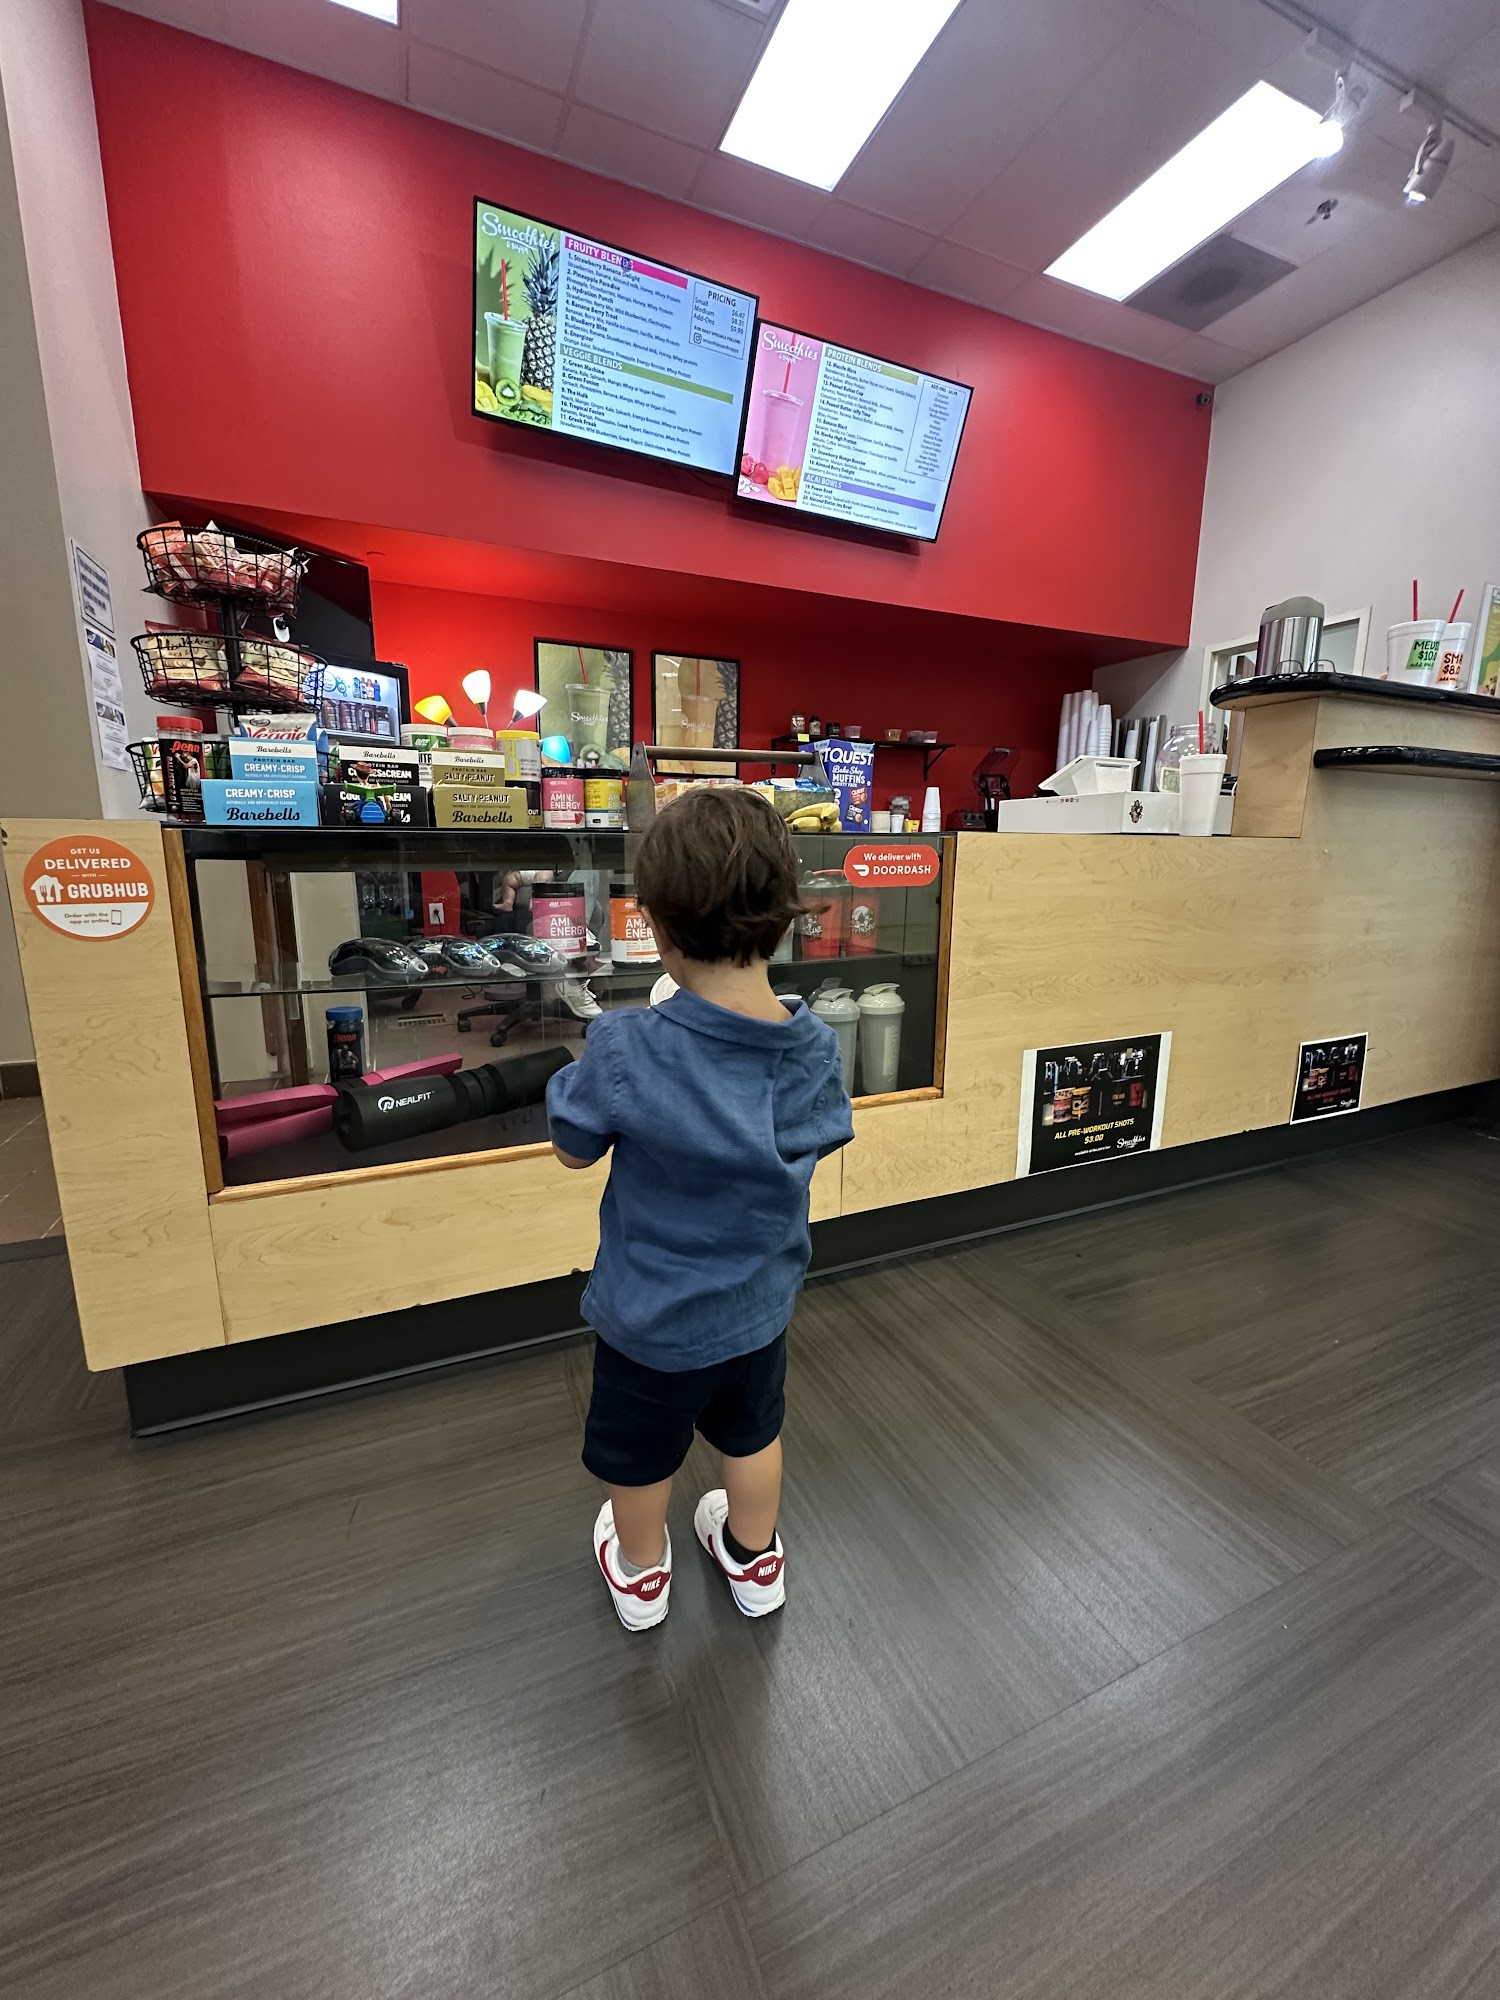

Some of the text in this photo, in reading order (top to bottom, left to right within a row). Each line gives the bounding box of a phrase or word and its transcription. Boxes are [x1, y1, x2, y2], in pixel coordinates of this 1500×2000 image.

[482, 212, 556, 251] Smoothies
[568, 239, 633, 268] FRUITY BLENDS
[574, 254, 601, 270] Strawberry
[602, 264, 621, 275] Banana
[622, 270, 640, 282] Delight
[573, 270, 598, 283] Pineapple
[599, 279, 620, 290] Paradise
[572, 285, 597, 298] Hydration
[598, 294, 613, 303] Punch
[695, 296, 708, 306] Small
[708, 290, 736, 306] PRICING
[571, 300, 590, 311] Banana
[591, 306, 604, 316] Berry
[605, 311, 617, 320] Treat
[694, 305, 714, 316] Medium
[693, 313, 714, 325] Add-Ons
[596, 323, 607, 331] Bliss
[570, 330, 593, 341] Energizer
[762, 331, 818, 360] Smoothies
[563, 346, 622, 369] VEGGIE BLENDS
[827, 349, 881, 372] PROTEIN BLENDS
[568, 359, 583, 368] Green
[584, 364, 604, 374] Machine
[567, 373, 582, 382] Green
[583, 377, 599, 386] Fusion
[569, 402, 588, 411] Tropical
[588, 407, 604, 416] Fusion
[806, 474, 841, 488] ACAI BOWLS
[257, 746, 292, 754] Barebells
[363, 751, 396, 759] Barebells
[829, 748, 875, 766] QUEST
[454, 756, 484, 764] Barebells
[833, 774, 866, 784] MUFFINS
[550, 801, 581, 810] ENERGY
[227, 807, 301, 821] Barebells
[452, 810, 512, 823] Barebells
[44, 858, 131, 870] DELIVERED
[864, 853, 922, 861] We deliver with
[873, 865, 932, 875] DOORDASH
[67, 882, 149, 899] GRUBHUB
[550, 927, 587, 937] ENERGY
[396, 1092, 432, 1108] NEALFIT
[1054, 1118, 1135, 1140] ALL PRE-WORKOUT SHOTS
[1084, 1134, 1105, 1145] $3.00
[758, 1560, 777, 1578] NIKE
[641, 1576, 662, 1593] NIKE
